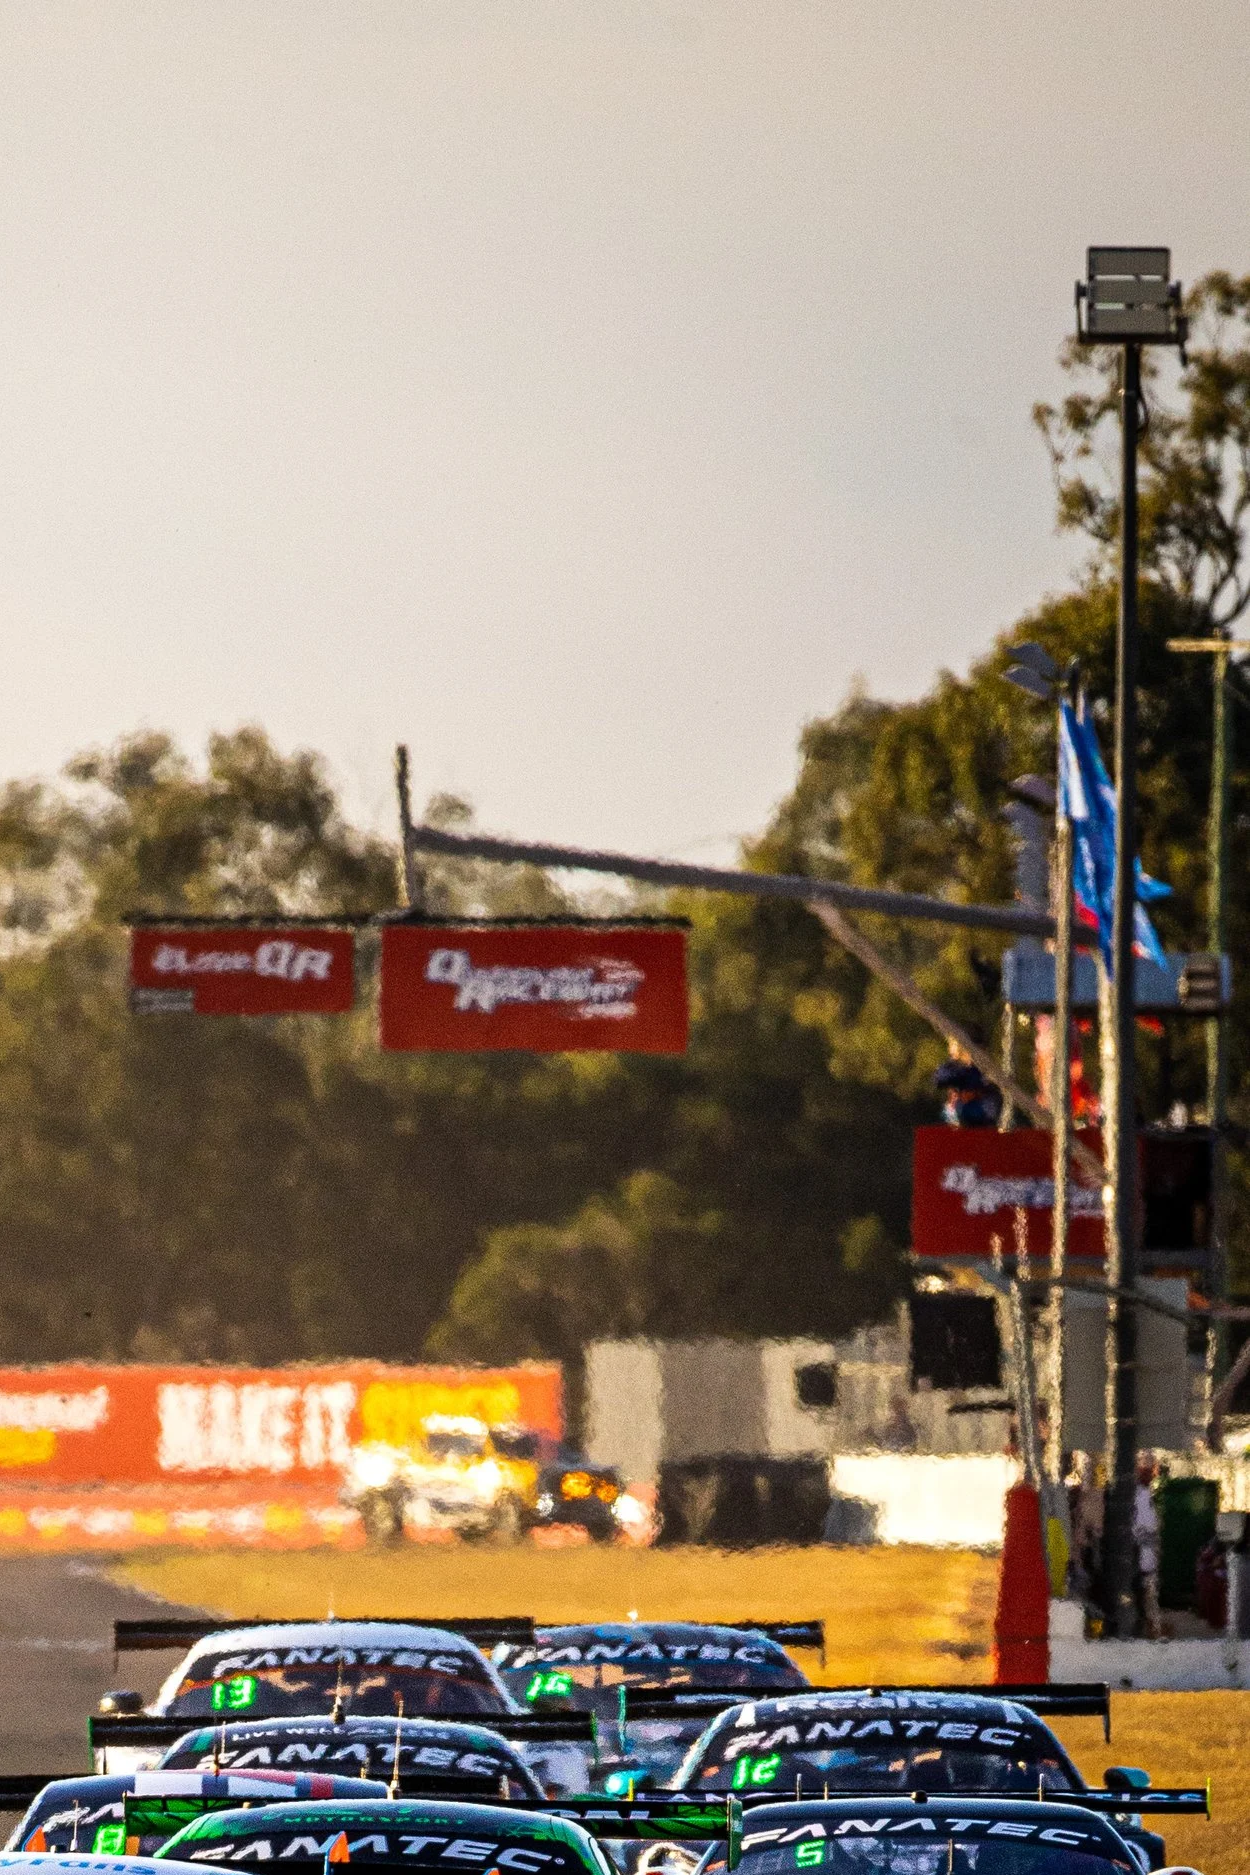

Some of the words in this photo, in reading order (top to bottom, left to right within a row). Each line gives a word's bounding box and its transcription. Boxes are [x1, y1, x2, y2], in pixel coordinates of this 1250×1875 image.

[212, 1648, 465, 1678] FANATEC
[725, 1719, 1023, 1761] FANATEC
[196, 1743, 502, 1776] FANATEC
[284, 1815, 467, 1827] MOTORSPORT
[742, 1818, 1091, 1851] FANATEC
[190, 1834, 552, 1873] FANATEC
[796, 1839, 826, 1868] 5
